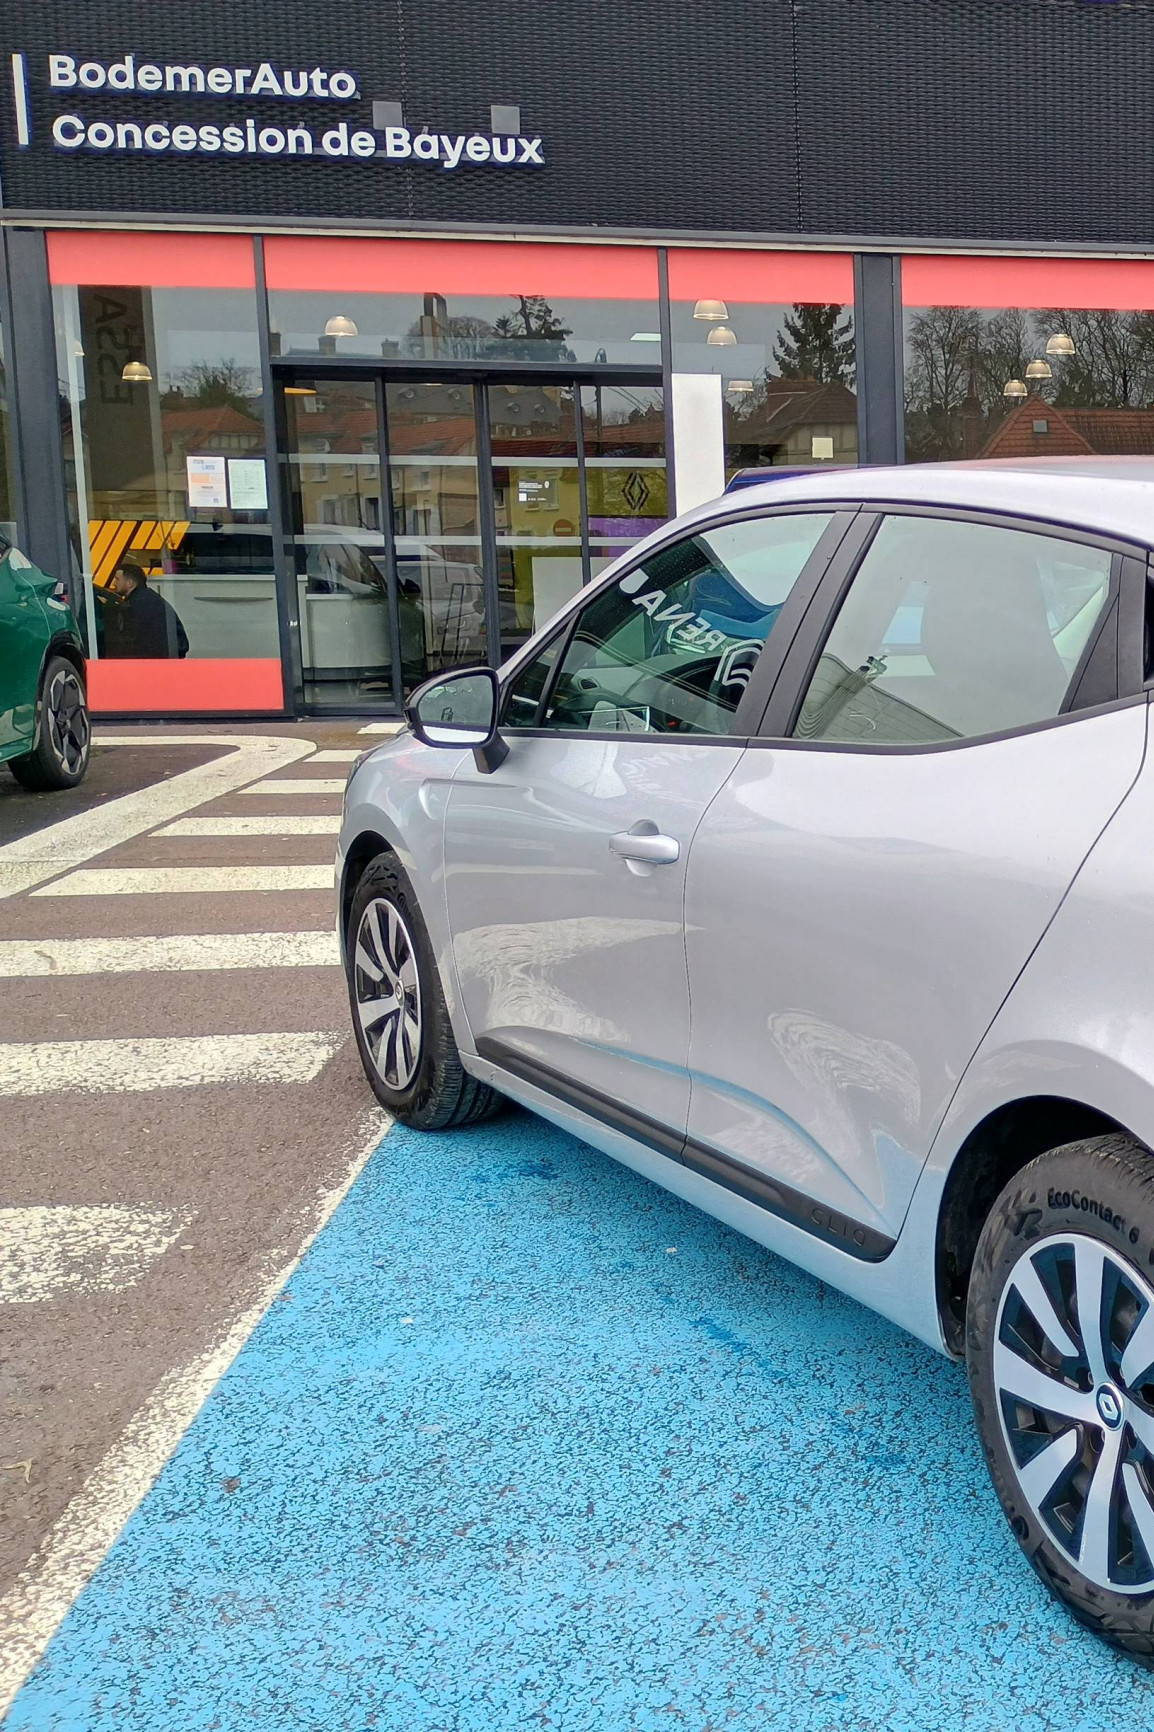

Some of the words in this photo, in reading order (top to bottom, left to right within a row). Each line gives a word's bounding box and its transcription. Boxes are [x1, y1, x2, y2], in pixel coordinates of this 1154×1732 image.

[49, 54, 358, 98] BodemerAuto
[52, 115, 312, 154] Concession
[322, 122, 376, 156] de
[385, 126, 544, 169] Bayeux
[811, 1207, 866, 1247] CLIO
[1047, 1187, 1126, 1235] EcoContact
